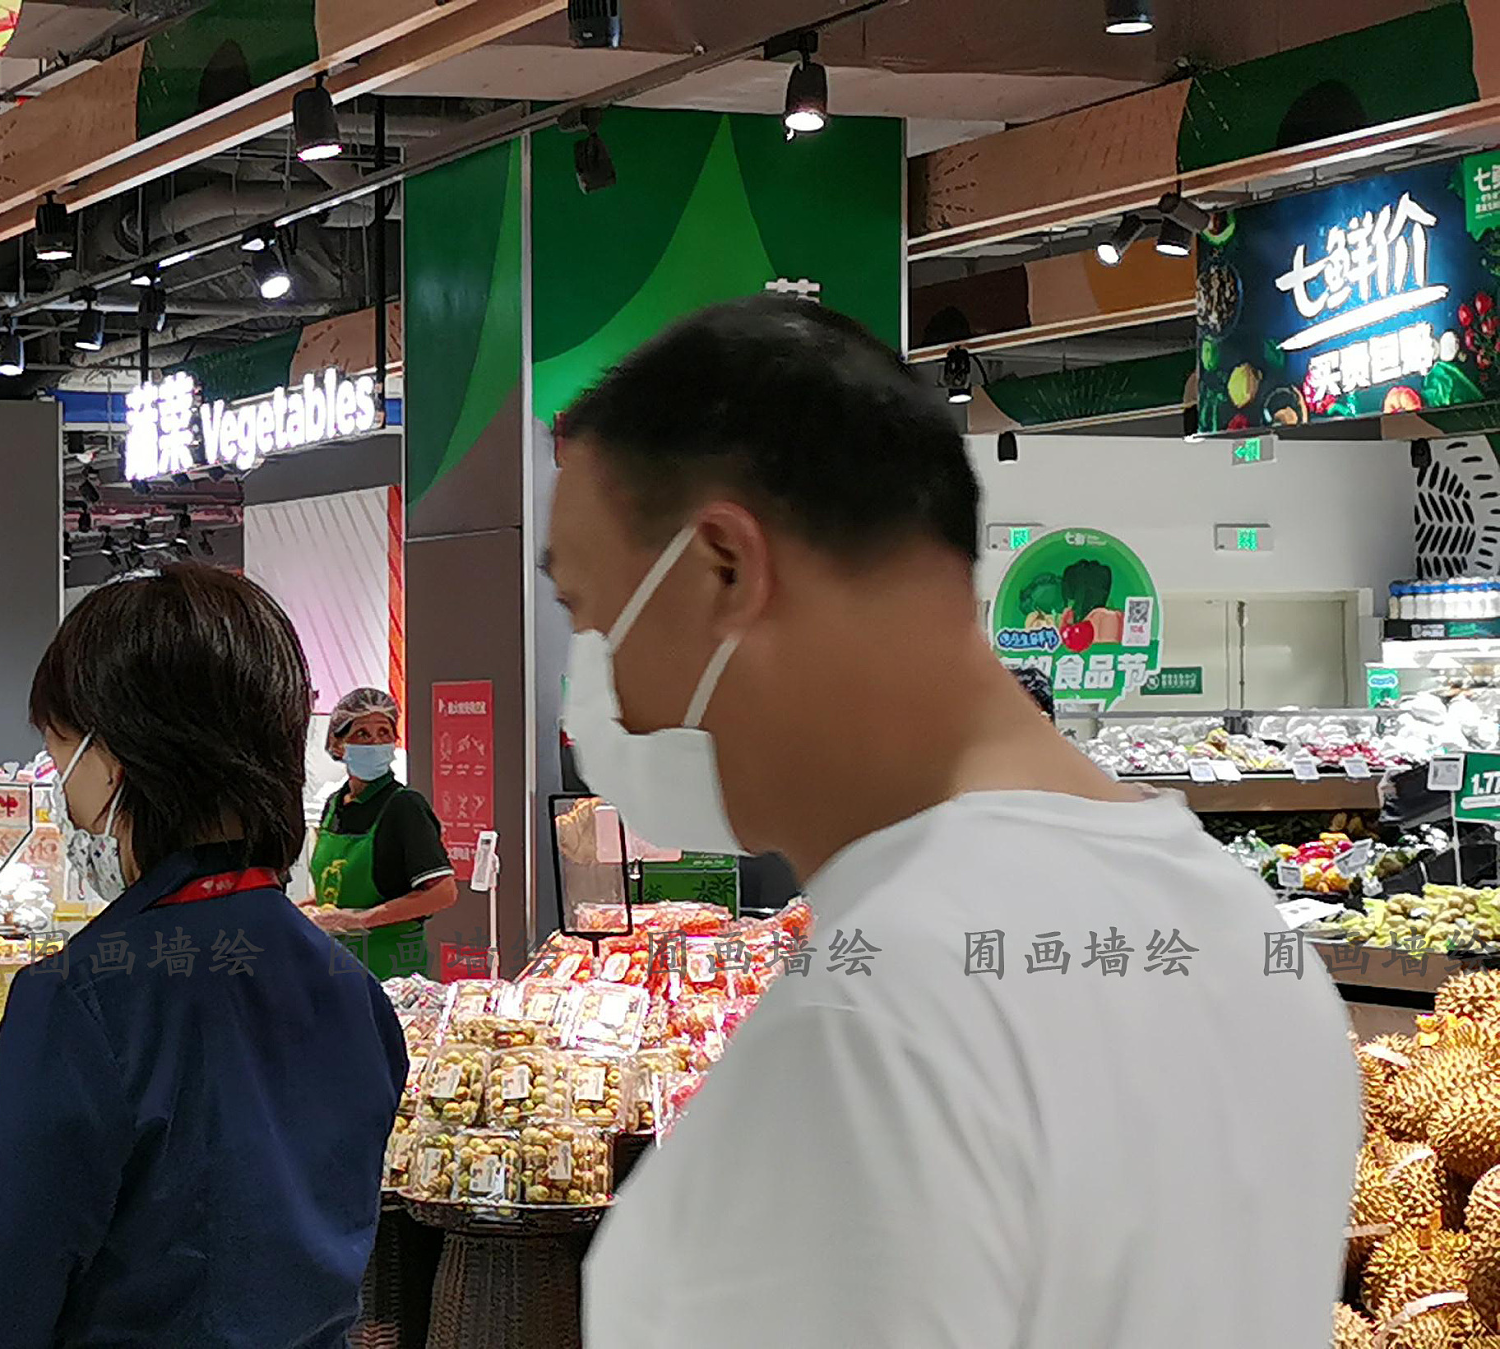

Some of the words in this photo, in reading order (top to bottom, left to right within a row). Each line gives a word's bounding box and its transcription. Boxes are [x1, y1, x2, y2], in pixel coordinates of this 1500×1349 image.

[1275, 191, 1438, 318] 七鲜价
[201, 365, 376, 471] Vegetables
